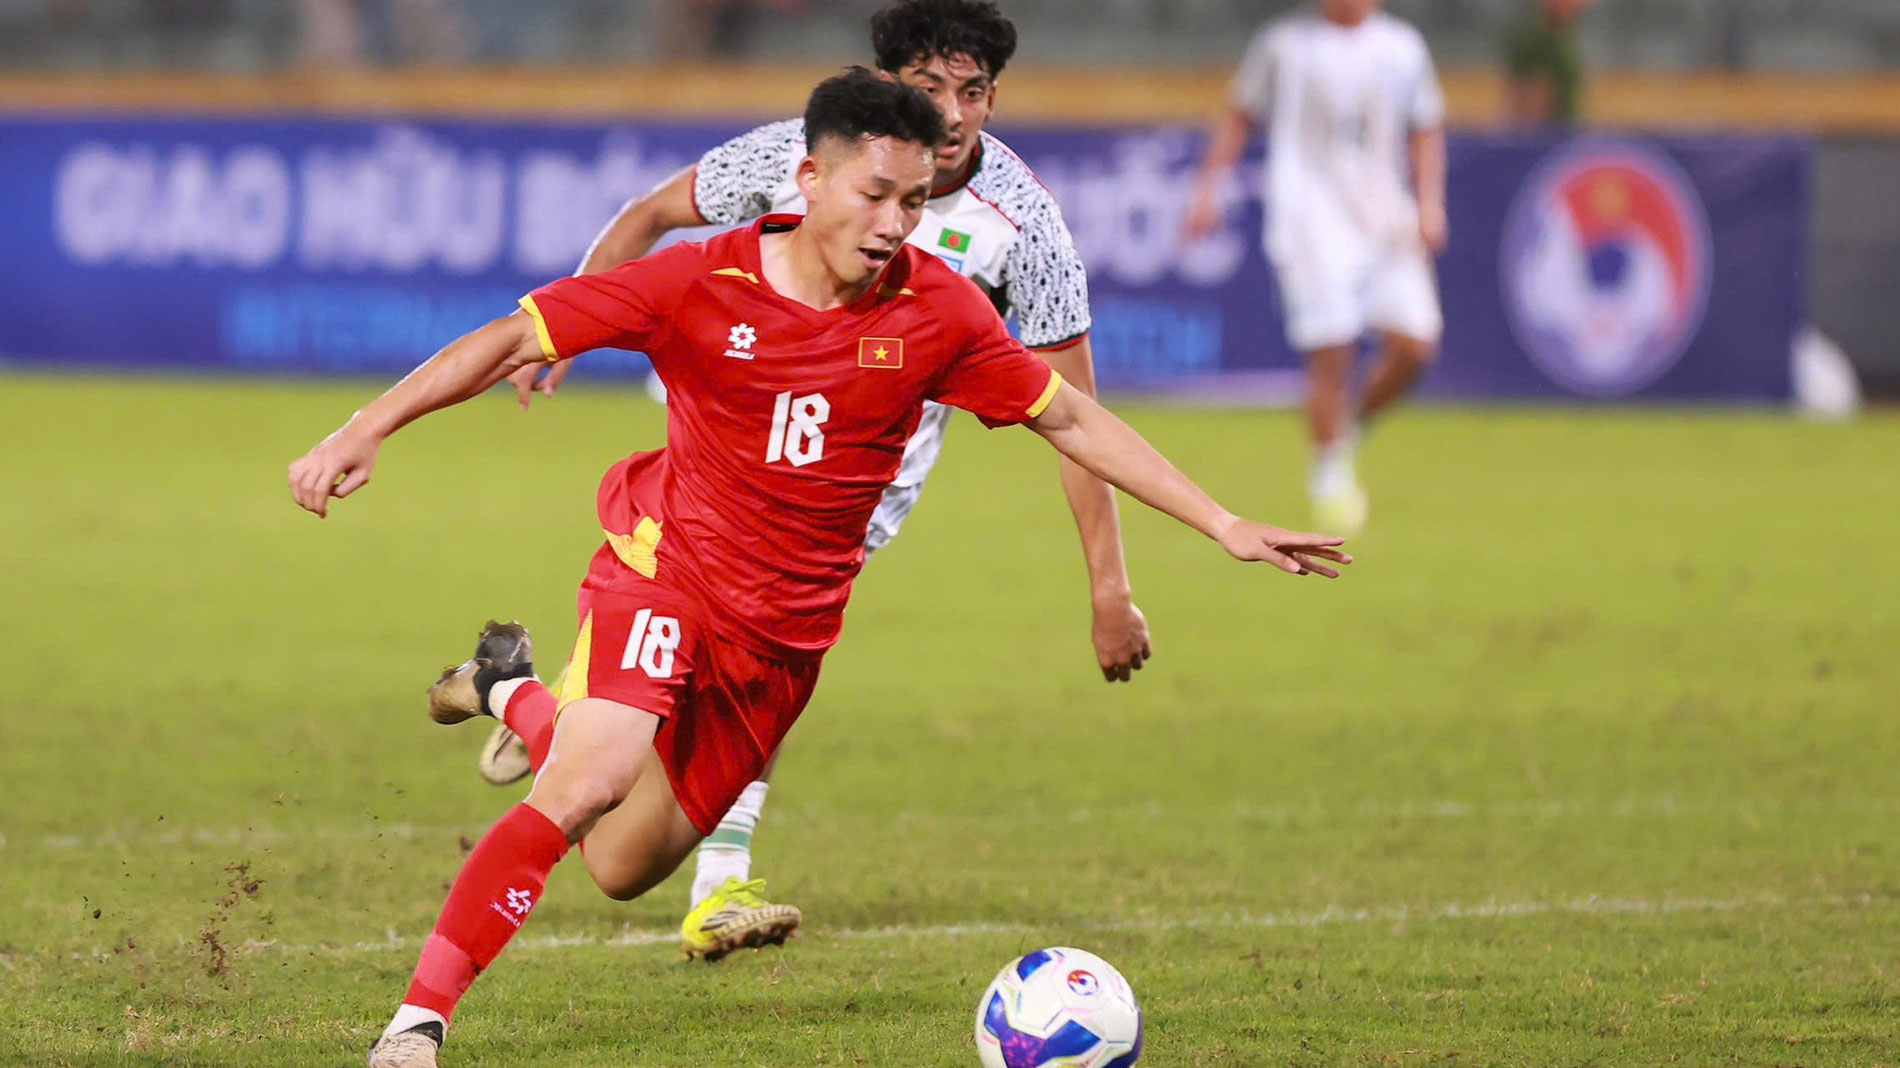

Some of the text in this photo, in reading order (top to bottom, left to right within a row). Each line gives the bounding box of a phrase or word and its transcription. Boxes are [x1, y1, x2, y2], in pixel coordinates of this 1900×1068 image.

[55, 142, 291, 270] GIAO
[765, 390, 831, 467] 18
[620, 608, 682, 679] 18
